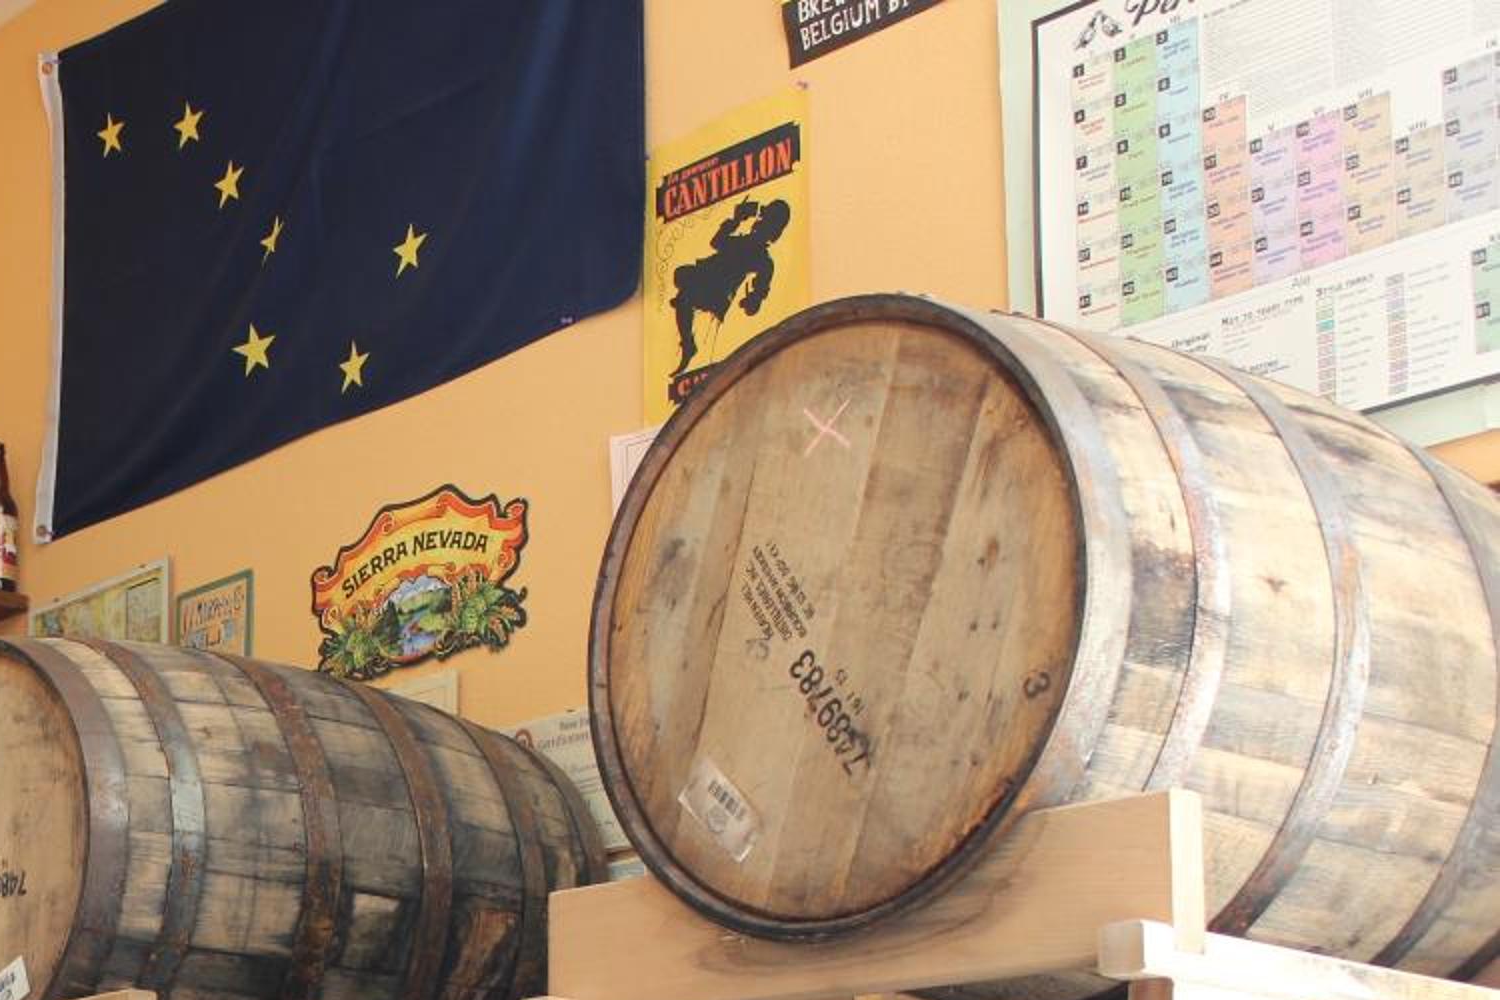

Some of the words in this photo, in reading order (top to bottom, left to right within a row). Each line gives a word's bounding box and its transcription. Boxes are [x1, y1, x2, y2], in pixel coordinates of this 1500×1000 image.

[797, 0, 844, 23] BRE
[800, 0, 881, 51] BELGIUM
[664, 137, 792, 219] CANTILLON
[342, 541, 409, 599] SIERRA
[412, 529, 488, 556] NEVADA
[788, 648, 874, 778] 7489783
